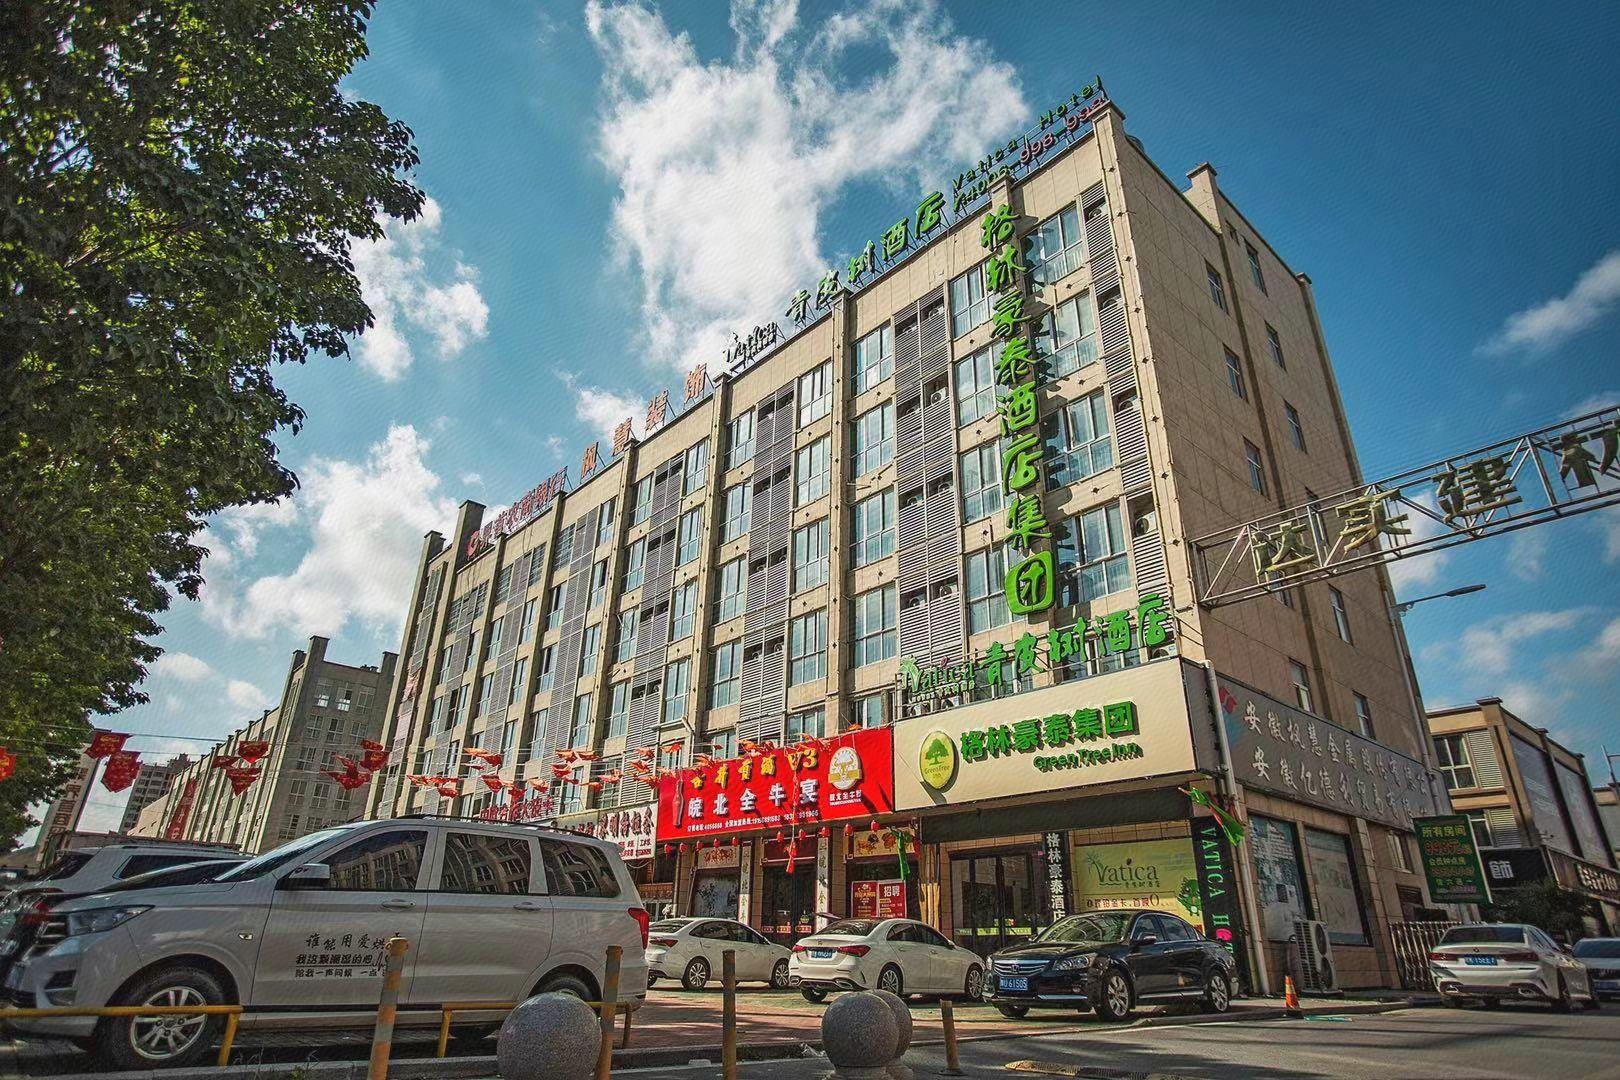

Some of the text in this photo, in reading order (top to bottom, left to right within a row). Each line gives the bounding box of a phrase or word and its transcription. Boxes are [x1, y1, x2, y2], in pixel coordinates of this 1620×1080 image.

[1039, 75, 1102, 129] Hotel
[785, 191, 946, 323] 青皮树酒店
[981, 204, 1056, 615] 格林豪泰酒店集团
[978, 593, 1172, 686] 青皮树酒店
[960, 700, 1137, 762] 格林豪泰集团
[688, 778, 820, 818] 皖北全牛宴
[884, 885, 900, 897] 招聘
[1046, 832, 1067, 921] 格林豪泰酒店
[1090, 857, 1159, 882] Vatica
[1201, 827, 1226, 898] VATICA
